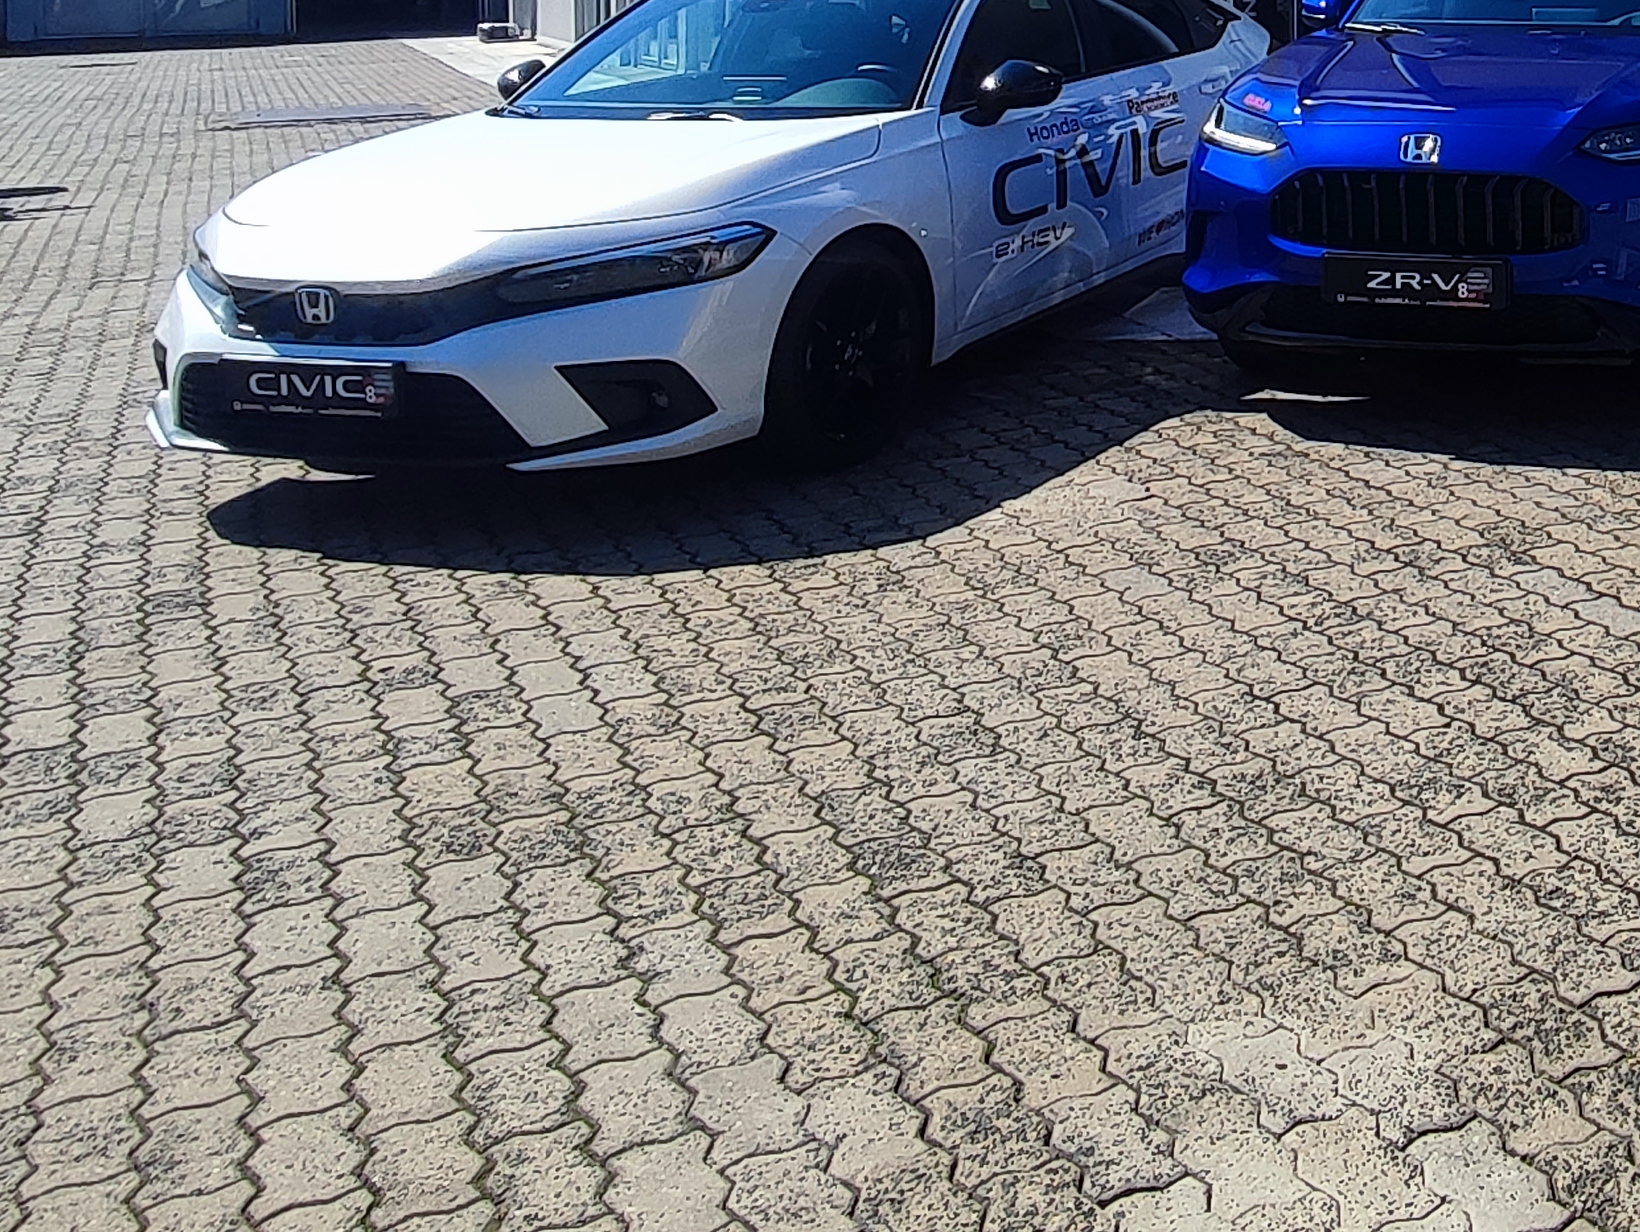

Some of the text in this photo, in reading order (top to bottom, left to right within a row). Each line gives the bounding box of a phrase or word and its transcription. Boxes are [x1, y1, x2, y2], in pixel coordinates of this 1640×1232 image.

[1026, 116, 1081, 143] Honda
[992, 118, 1188, 226] CIVIC
[1366, 271, 1461, 290] ZR-V
[1457, 283, 1468, 298] 8
[249, 372, 366, 398] CIVIC
[365, 385, 376, 403] 8
